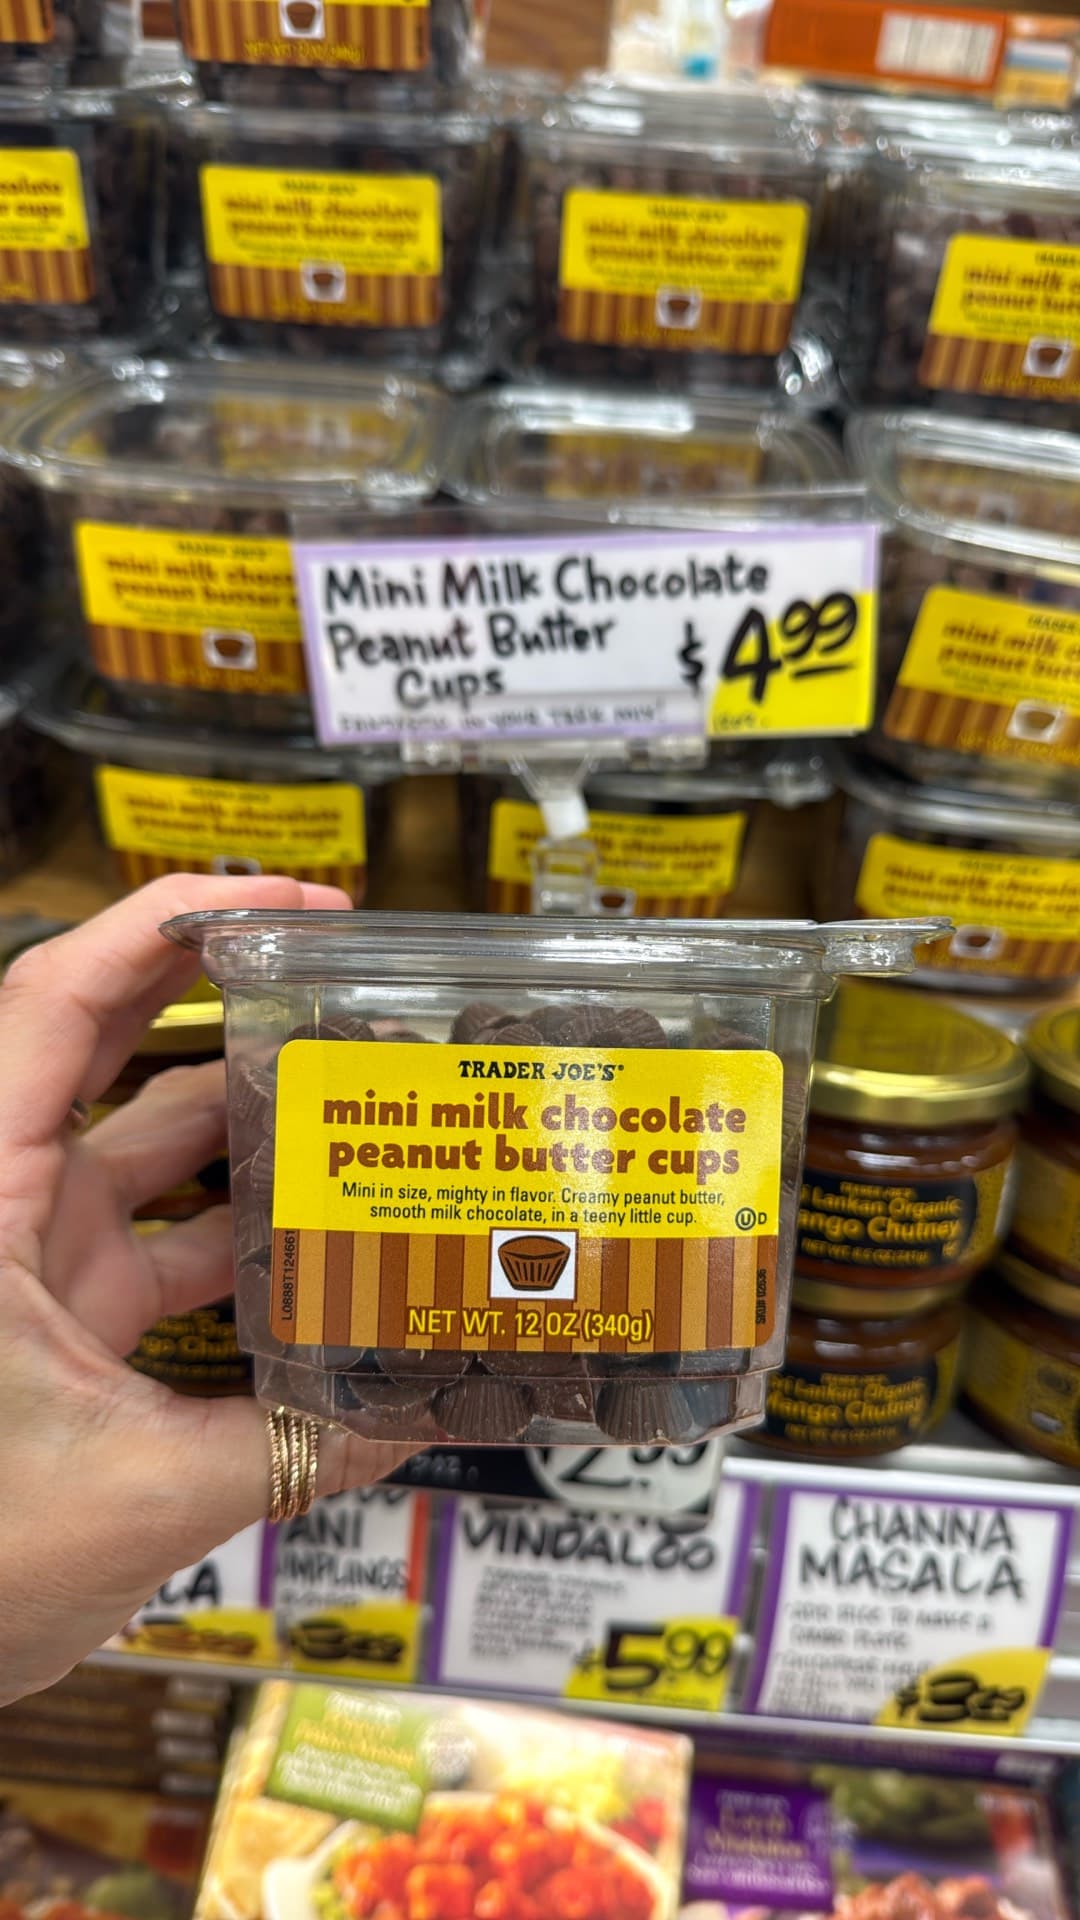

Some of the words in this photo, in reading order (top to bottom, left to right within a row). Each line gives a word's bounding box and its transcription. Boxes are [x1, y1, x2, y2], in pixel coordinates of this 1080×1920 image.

[325, 564, 427, 613] Mini
[441, 560, 541, 607] Milk
[554, 554, 769, 604] Chocolate
[325, 616, 477, 674] Peanut
[488, 609, 615, 658] Butter
[395, 668, 505, 711] Cups
[458, 1060, 546, 1080] TRADER
[323, 1089, 418, 1127] mini
[431, 1092, 529, 1130] milk
[541, 1094, 747, 1133] chocolate
[328, 1139, 482, 1177] peanut
[495, 1134, 636, 1174] butter
[647, 1149, 740, 1185] cups
[342, 1181, 376, 1198] Mini
[380, 1183, 393, 1199] in
[398, 1184, 432, 1202] size,
[436, 1185, 488, 1205] mighty
[492, 1186, 505, 1202] in
[510, 1186, 556, 1203] flavor.
[561, 1188, 620, 1207] Creamy
[624, 1190, 677, 1206] peanut
[680, 1190, 726, 1207] butter,
[370, 1203, 426, 1219] smooth
[431, 1204, 461, 1220] milk
[466, 1205, 548, 1224] chocolate,
[551, 1208, 566, 1223] in
[570, 1211, 579, 1223] a
[583, 1209, 624, 1227] teeny
[629, 1208, 663, 1225] little
[666, 1211, 698, 1228] cup.
[812, 1185, 888, 1217] Lankan
[888, 1195, 964, 1222] Organic
[797, 1208, 865, 1242] ango
[867, 1214, 962, 1244] Chutney
[407, 1308, 457, 1334] NET
[462, 1309, 506, 1336] WT.
[514, 1311, 540, 1336] 12
[546, 1312, 578, 1337] OZ
[583, 1309, 653, 1343] (340g)
[462, 1508, 715, 1572] VINDALOO
[830, 1495, 1016, 1554] CHANNA
[798, 1543, 1025, 1600] MASALA
